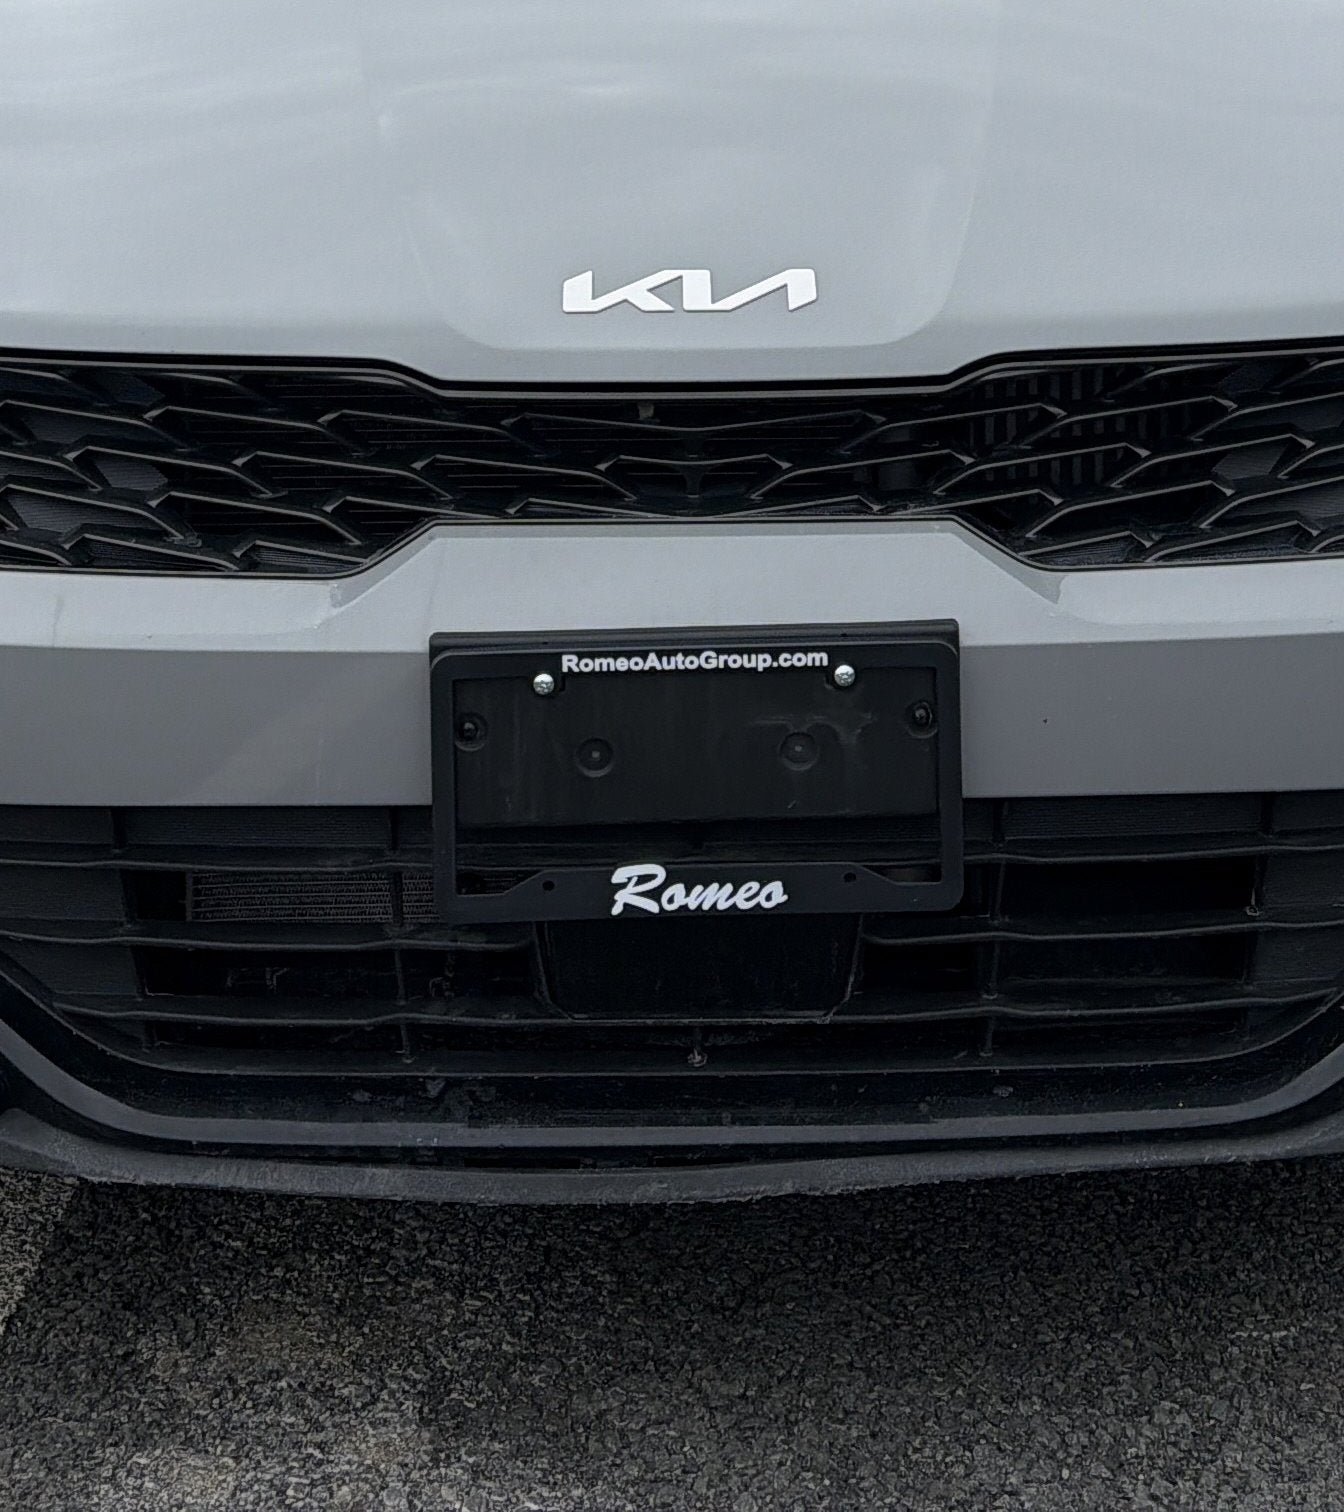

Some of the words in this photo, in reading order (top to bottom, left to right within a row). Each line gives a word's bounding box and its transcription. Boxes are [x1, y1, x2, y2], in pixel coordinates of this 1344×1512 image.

[562, 268, 818, 313] KIA
[561, 651, 828, 673] RomeoAutoGroup.com
[611, 863, 788, 916] Romeo
